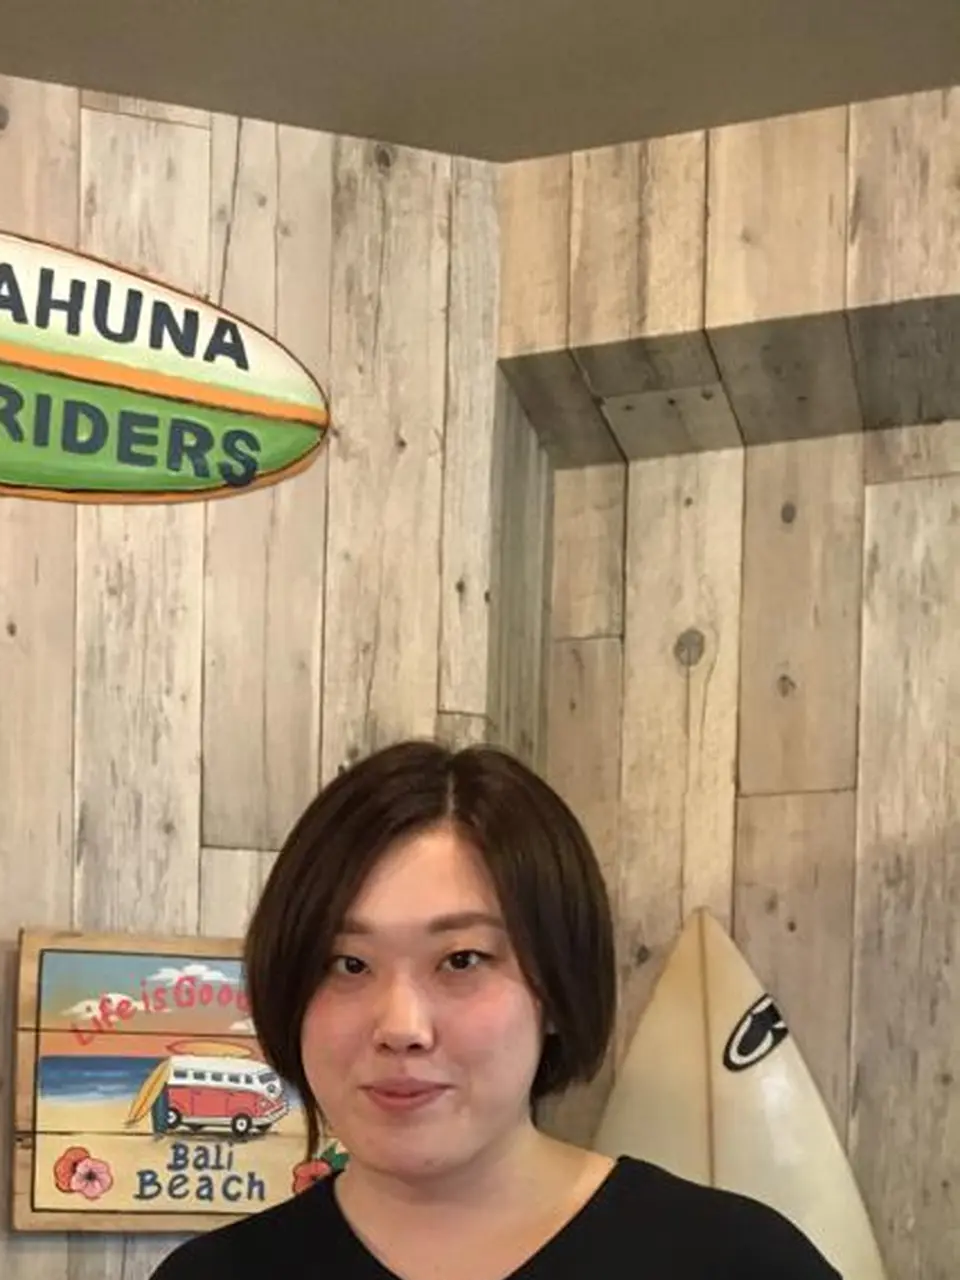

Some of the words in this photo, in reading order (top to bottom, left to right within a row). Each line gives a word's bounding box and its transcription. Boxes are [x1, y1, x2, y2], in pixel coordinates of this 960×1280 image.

[70, 992, 137, 1046] Life
[140, 977, 169, 1013] is
[166, 1141, 235, 1171] Bali
[133, 1169, 266, 1203] Beach
